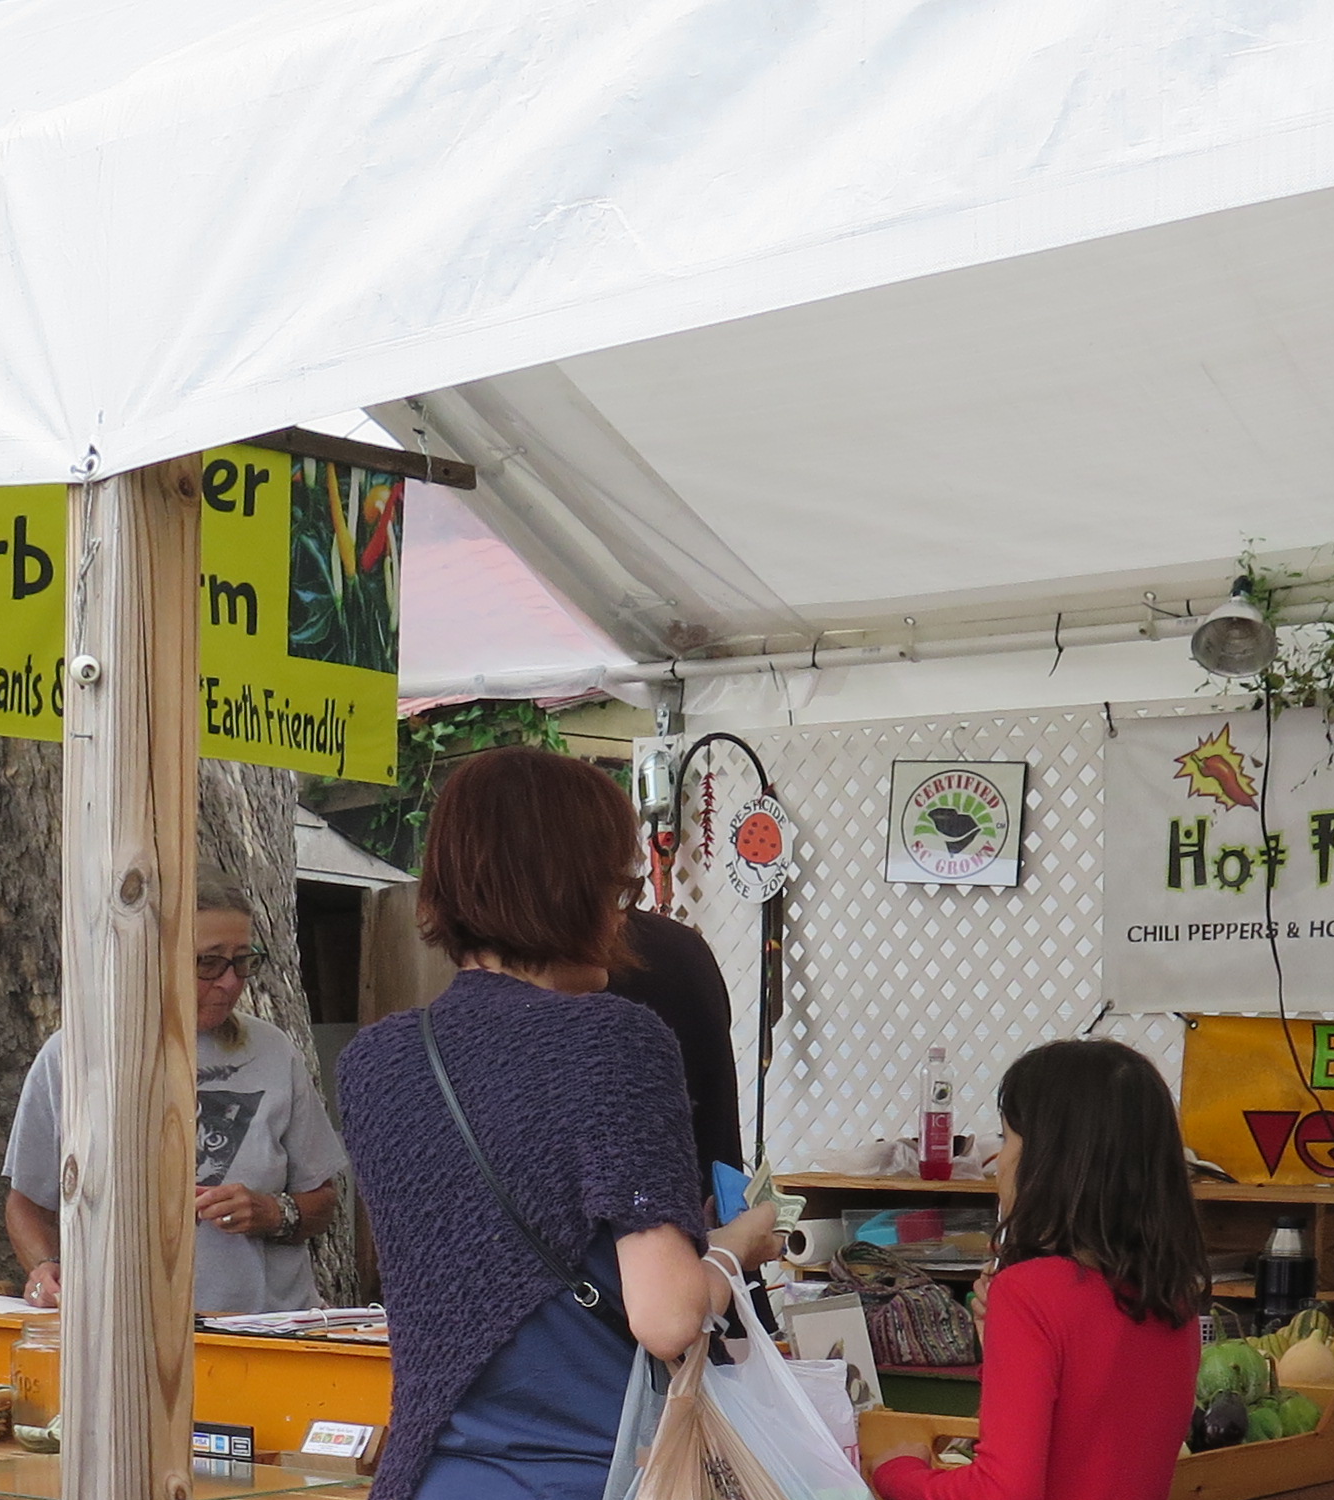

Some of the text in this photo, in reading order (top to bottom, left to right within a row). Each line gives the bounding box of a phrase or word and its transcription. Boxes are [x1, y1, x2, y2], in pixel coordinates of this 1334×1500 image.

[201, 457, 271, 518] er
[914, 774, 1001, 810] CERTIFIED
[729, 798, 787, 830] PESTICIDE
[911, 840, 996, 876] SC GROWN
[1167, 815, 1287, 892] Hot
[725, 857, 790, 899] FREE ZONE
[1127, 924, 1180, 943] CHILI
[1188, 921, 1279, 941] PEPPERS
[1287, 921, 1300, 938] &
